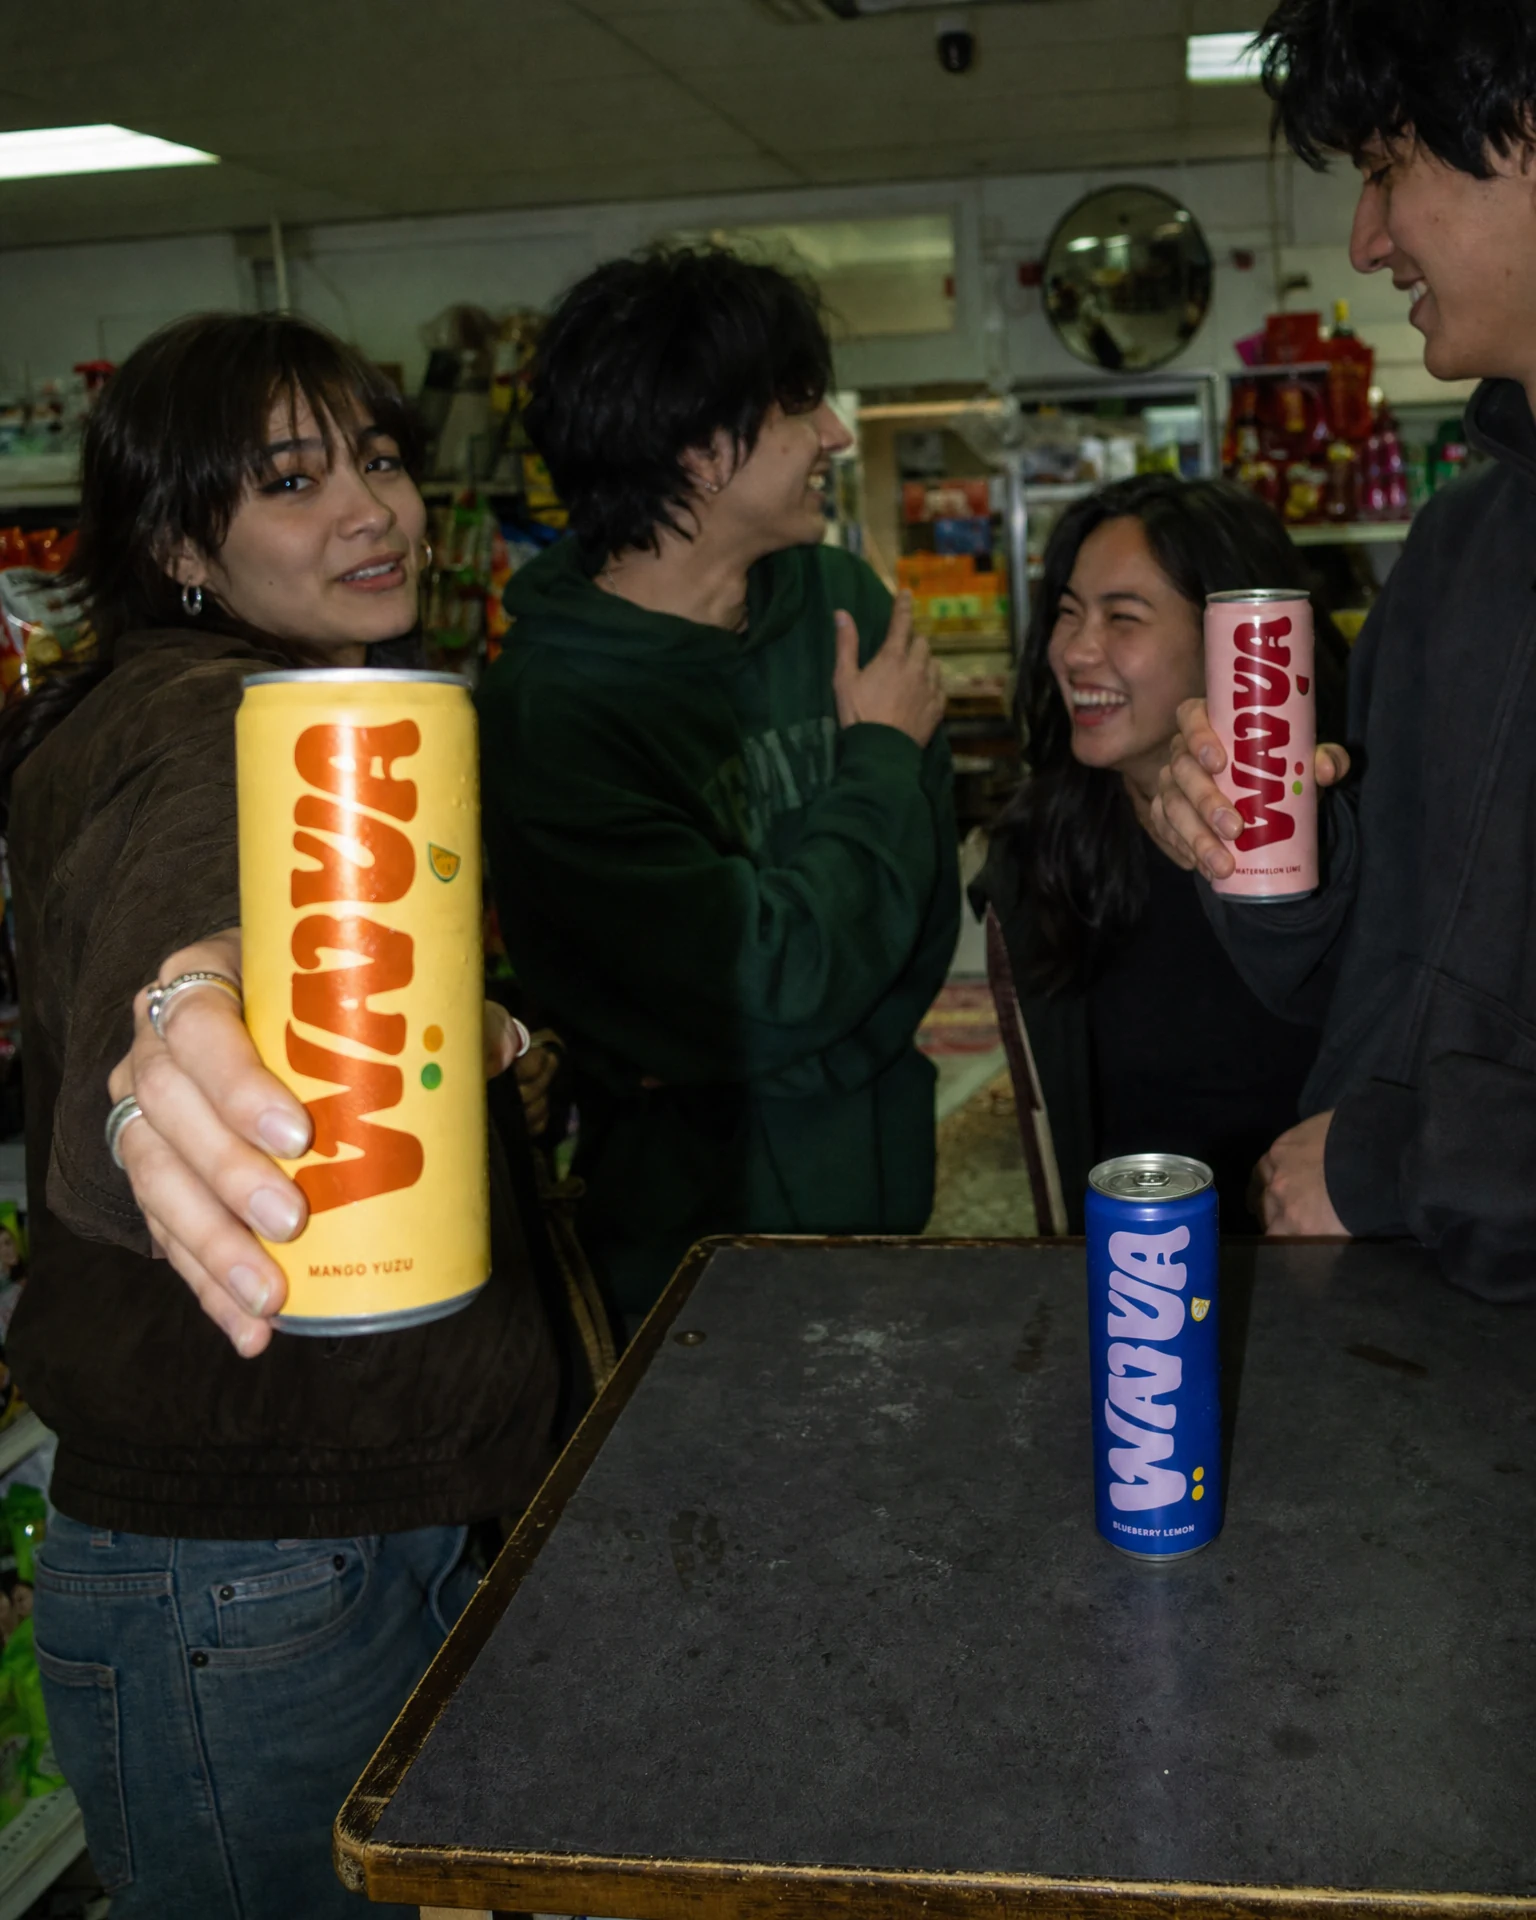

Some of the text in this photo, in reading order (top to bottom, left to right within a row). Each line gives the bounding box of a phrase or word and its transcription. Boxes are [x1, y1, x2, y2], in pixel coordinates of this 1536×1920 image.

[1235, 864, 1301, 876] WATERMELON LIME
[308, 1257, 414, 1277] MANGO YUZU
[1112, 1520, 1195, 1537] BLUEBERRY LEMON
